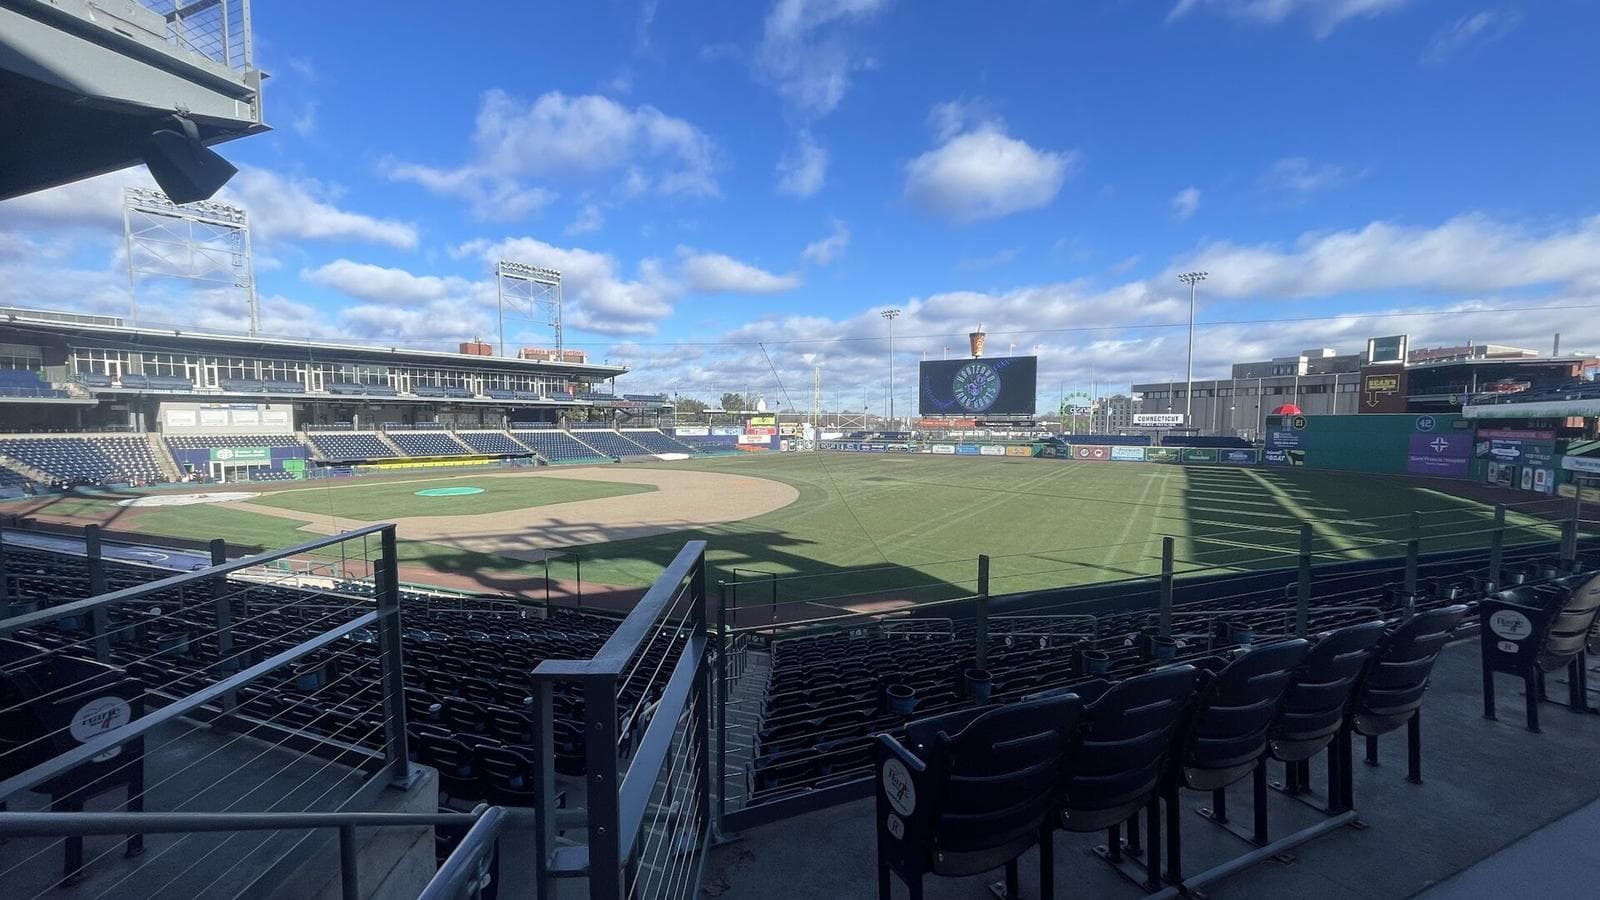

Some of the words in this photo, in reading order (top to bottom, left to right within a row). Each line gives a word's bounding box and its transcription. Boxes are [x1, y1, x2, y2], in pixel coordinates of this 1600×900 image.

[956, 365, 996, 383] HARTFORD
[954, 388, 971, 407] YARD
[973, 387, 997, 409] GOATS
[1295, 419, 1303, 427] 21
[1419, 419, 1431, 427] 42
